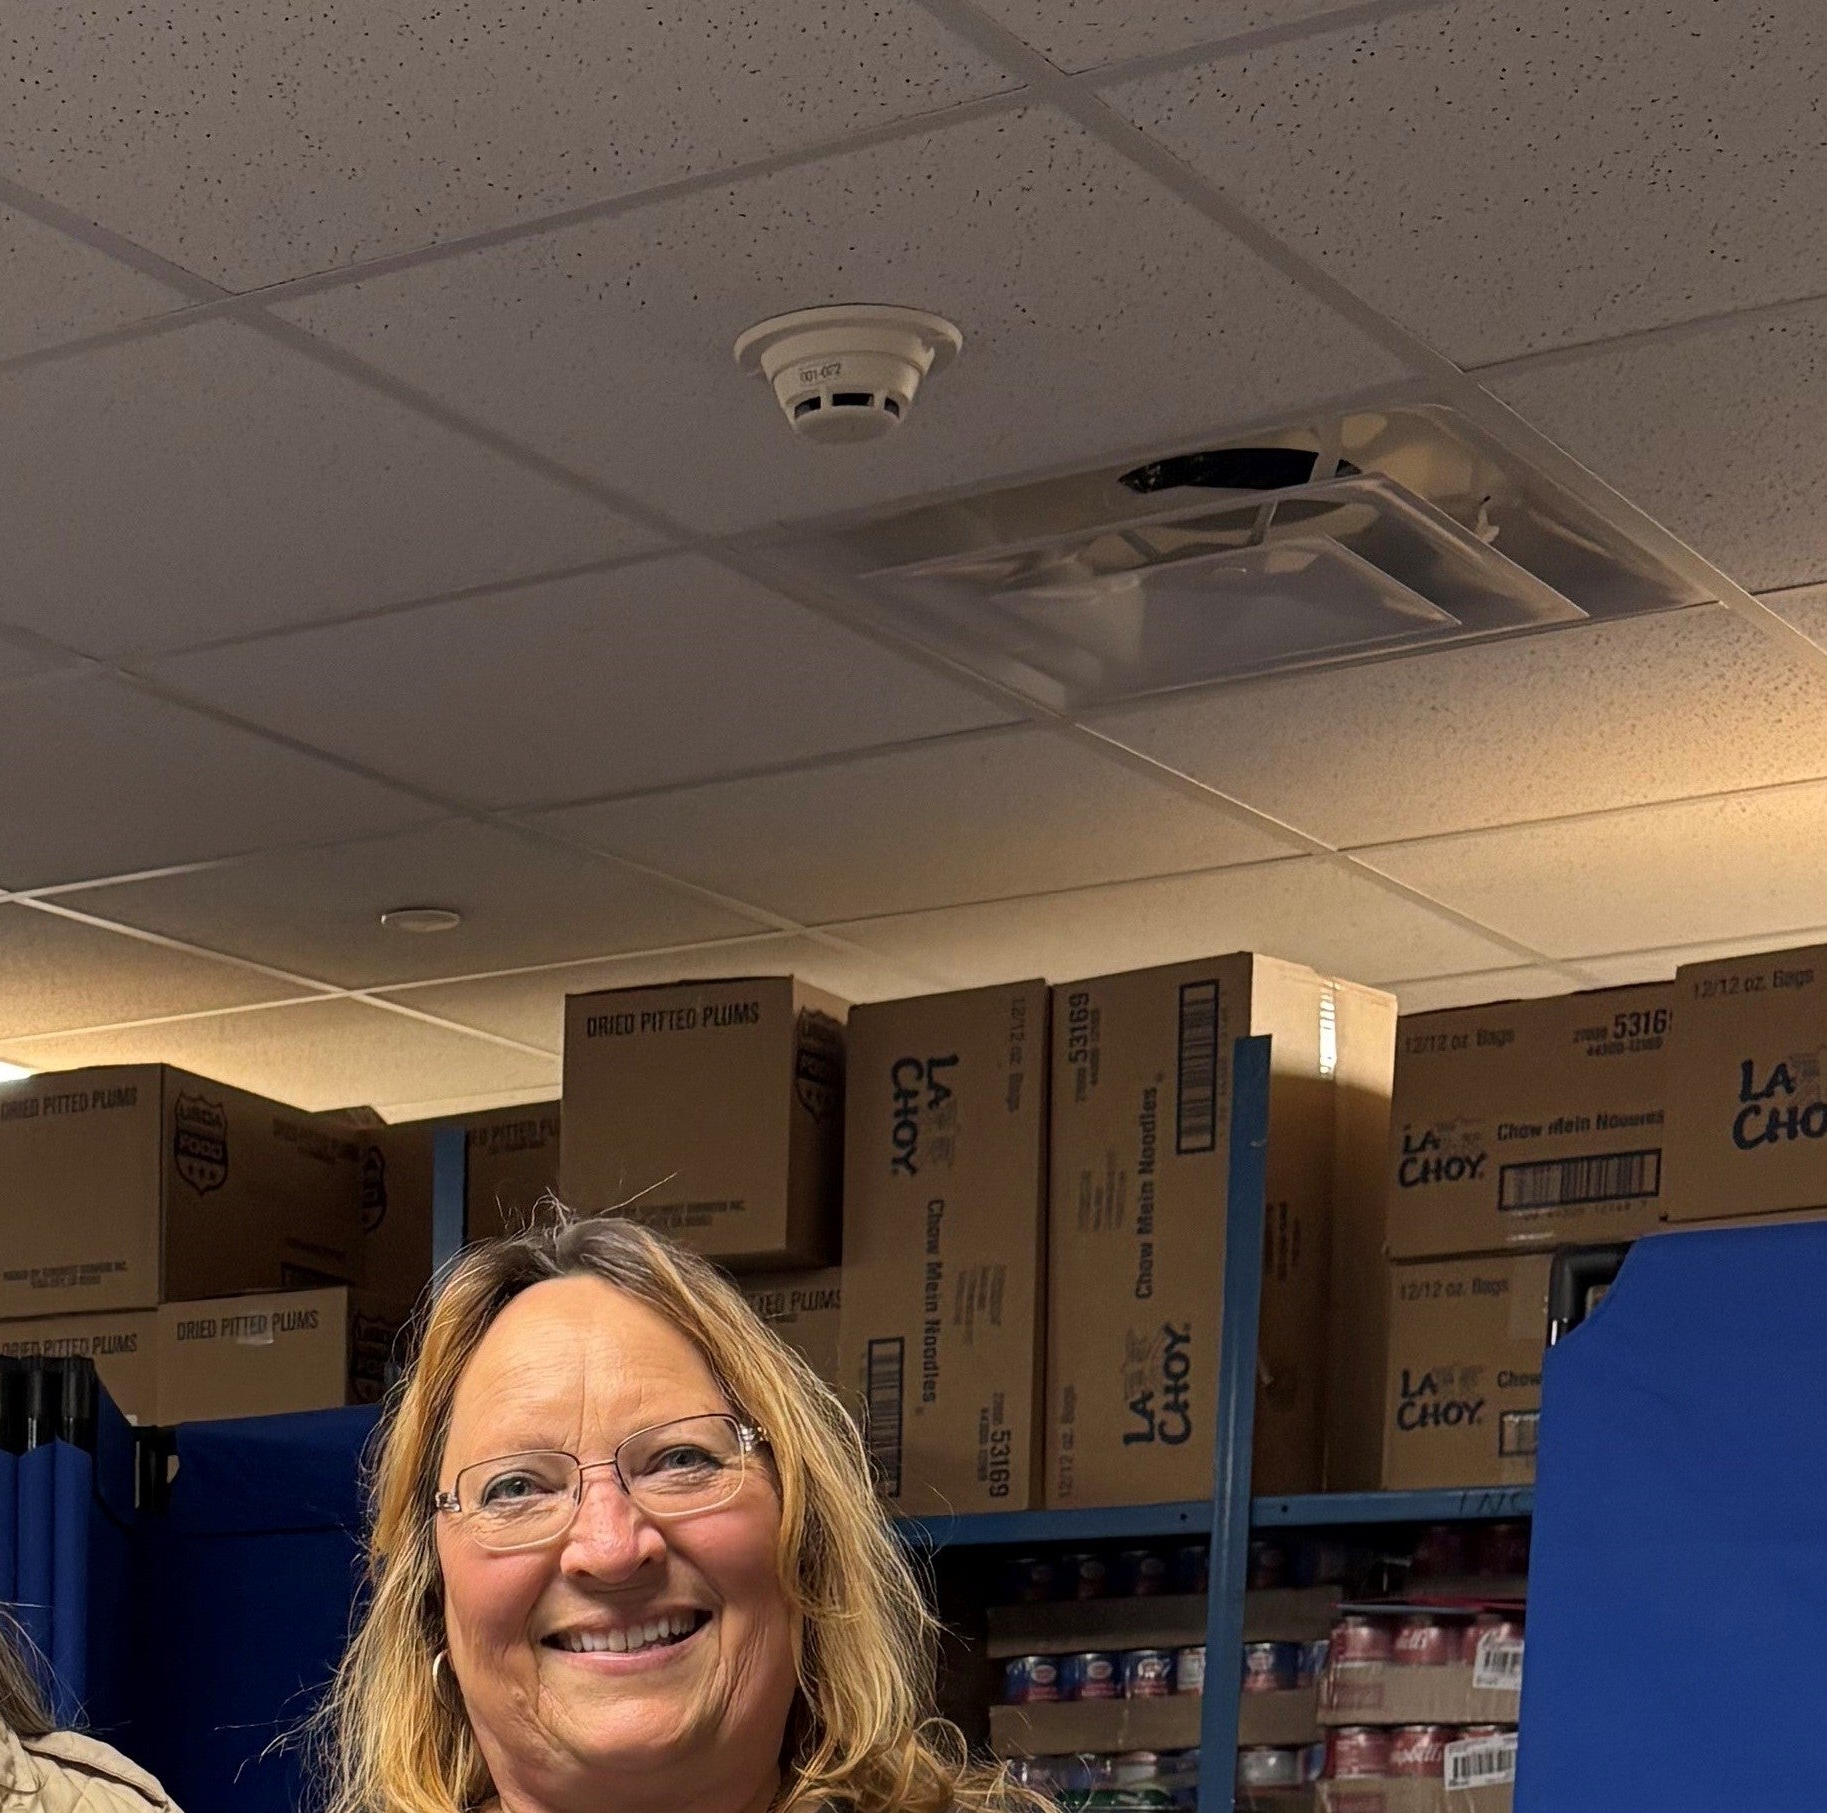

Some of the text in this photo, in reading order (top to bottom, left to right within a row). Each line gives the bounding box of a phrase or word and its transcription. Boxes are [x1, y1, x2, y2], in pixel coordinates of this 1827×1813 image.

[1773, 967, 1815, 989] Bags
[586, 1002, 760, 1038] DRIED PITTED PLUMS
[1069, 992, 1090, 1063] 53169
[1613, 1008, 1673, 1039] 5316
[926, 1053, 960, 1108] LA
[1737, 1058, 1796, 1104] LA
[42, 1092, 88, 1116] PITTED
[92, 1087, 137, 1110] PLUMS
[1137, 1087, 1158, 1178] Noodles
[1401, 1128, 1441, 1155] LA
[1497, 1121, 1542, 1142] Chow
[926, 1199, 944, 1254] Chow
[1135, 1242, 1153, 1301] Chow
[177, 1309, 320, 1341] DRIED PITTED PLUMS
[92, 1333, 137, 1355] PLUMS
[1401, 1368, 1438, 1398] LA
[1122, 1390, 1156, 1446] LA
[990, 1430, 1011, 1498] 53169
